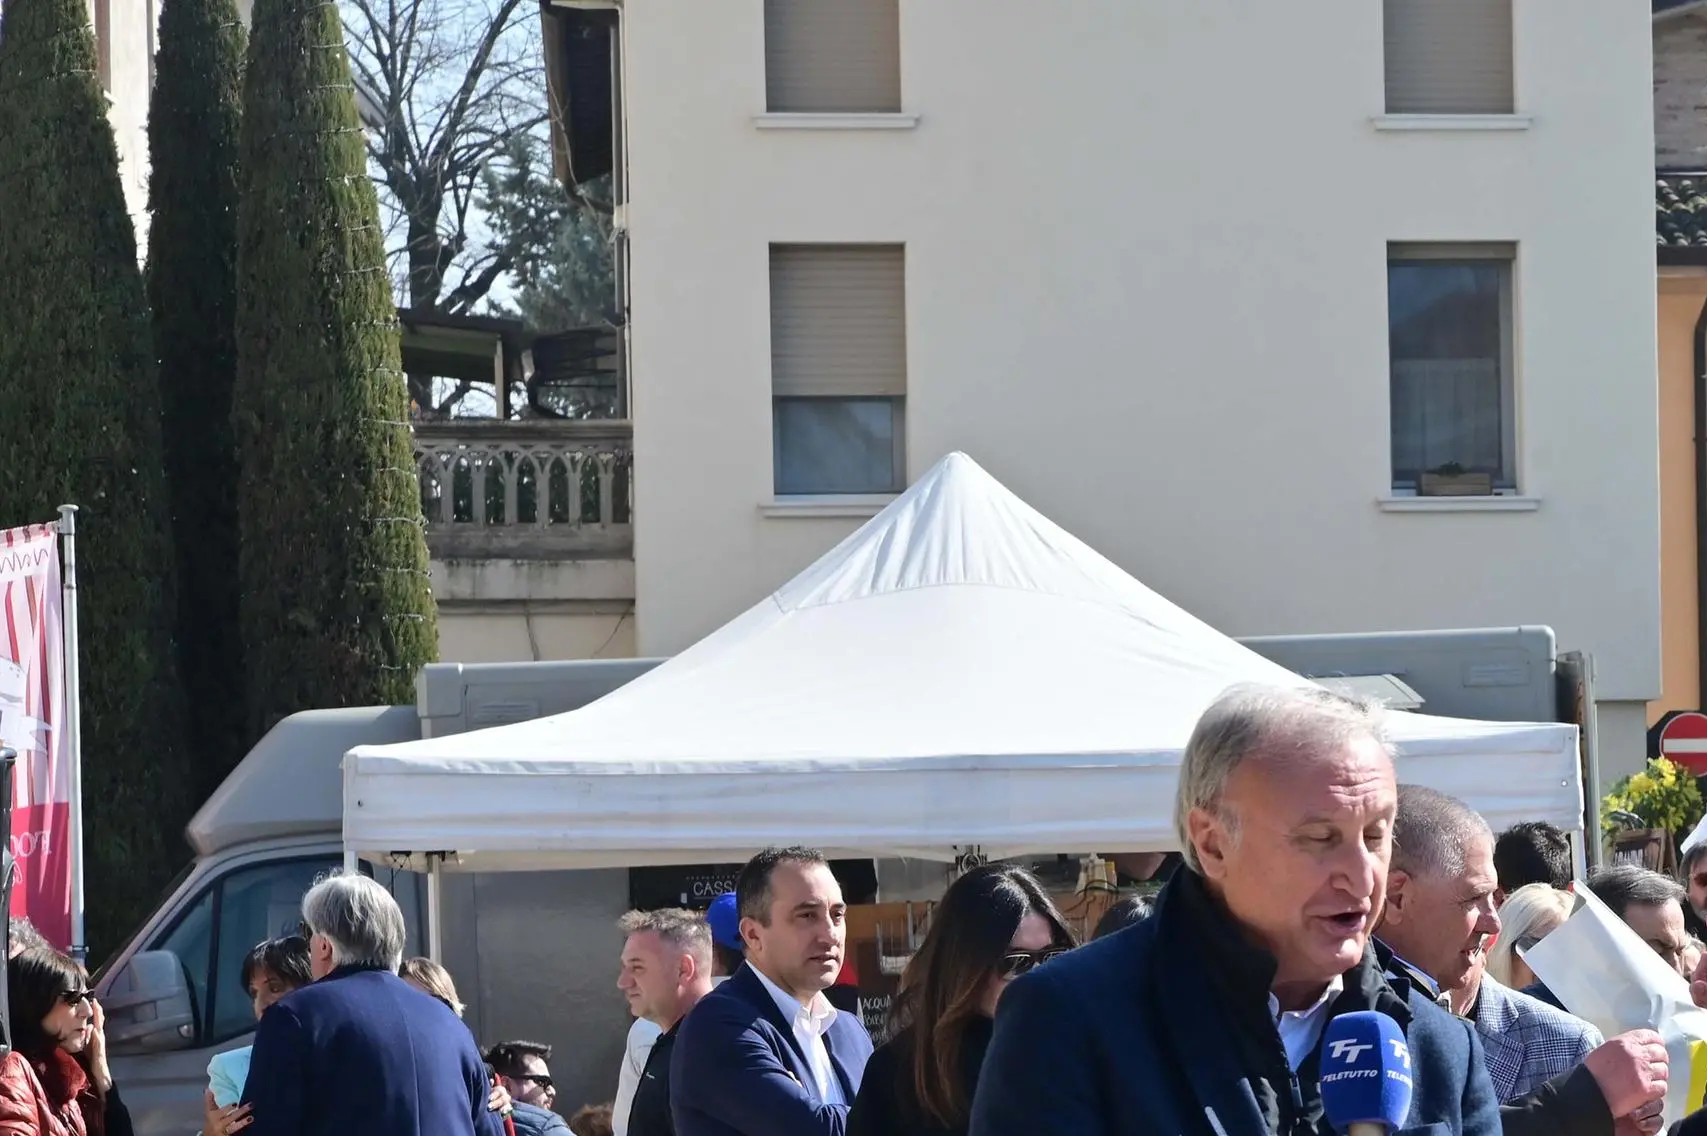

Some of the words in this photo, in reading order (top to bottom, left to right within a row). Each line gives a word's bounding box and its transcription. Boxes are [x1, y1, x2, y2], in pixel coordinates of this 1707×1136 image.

[693, 880, 737, 896] CASS
[1328, 1038, 1373, 1064] TT
[1322, 1069, 1378, 1083] TELETUTTO
